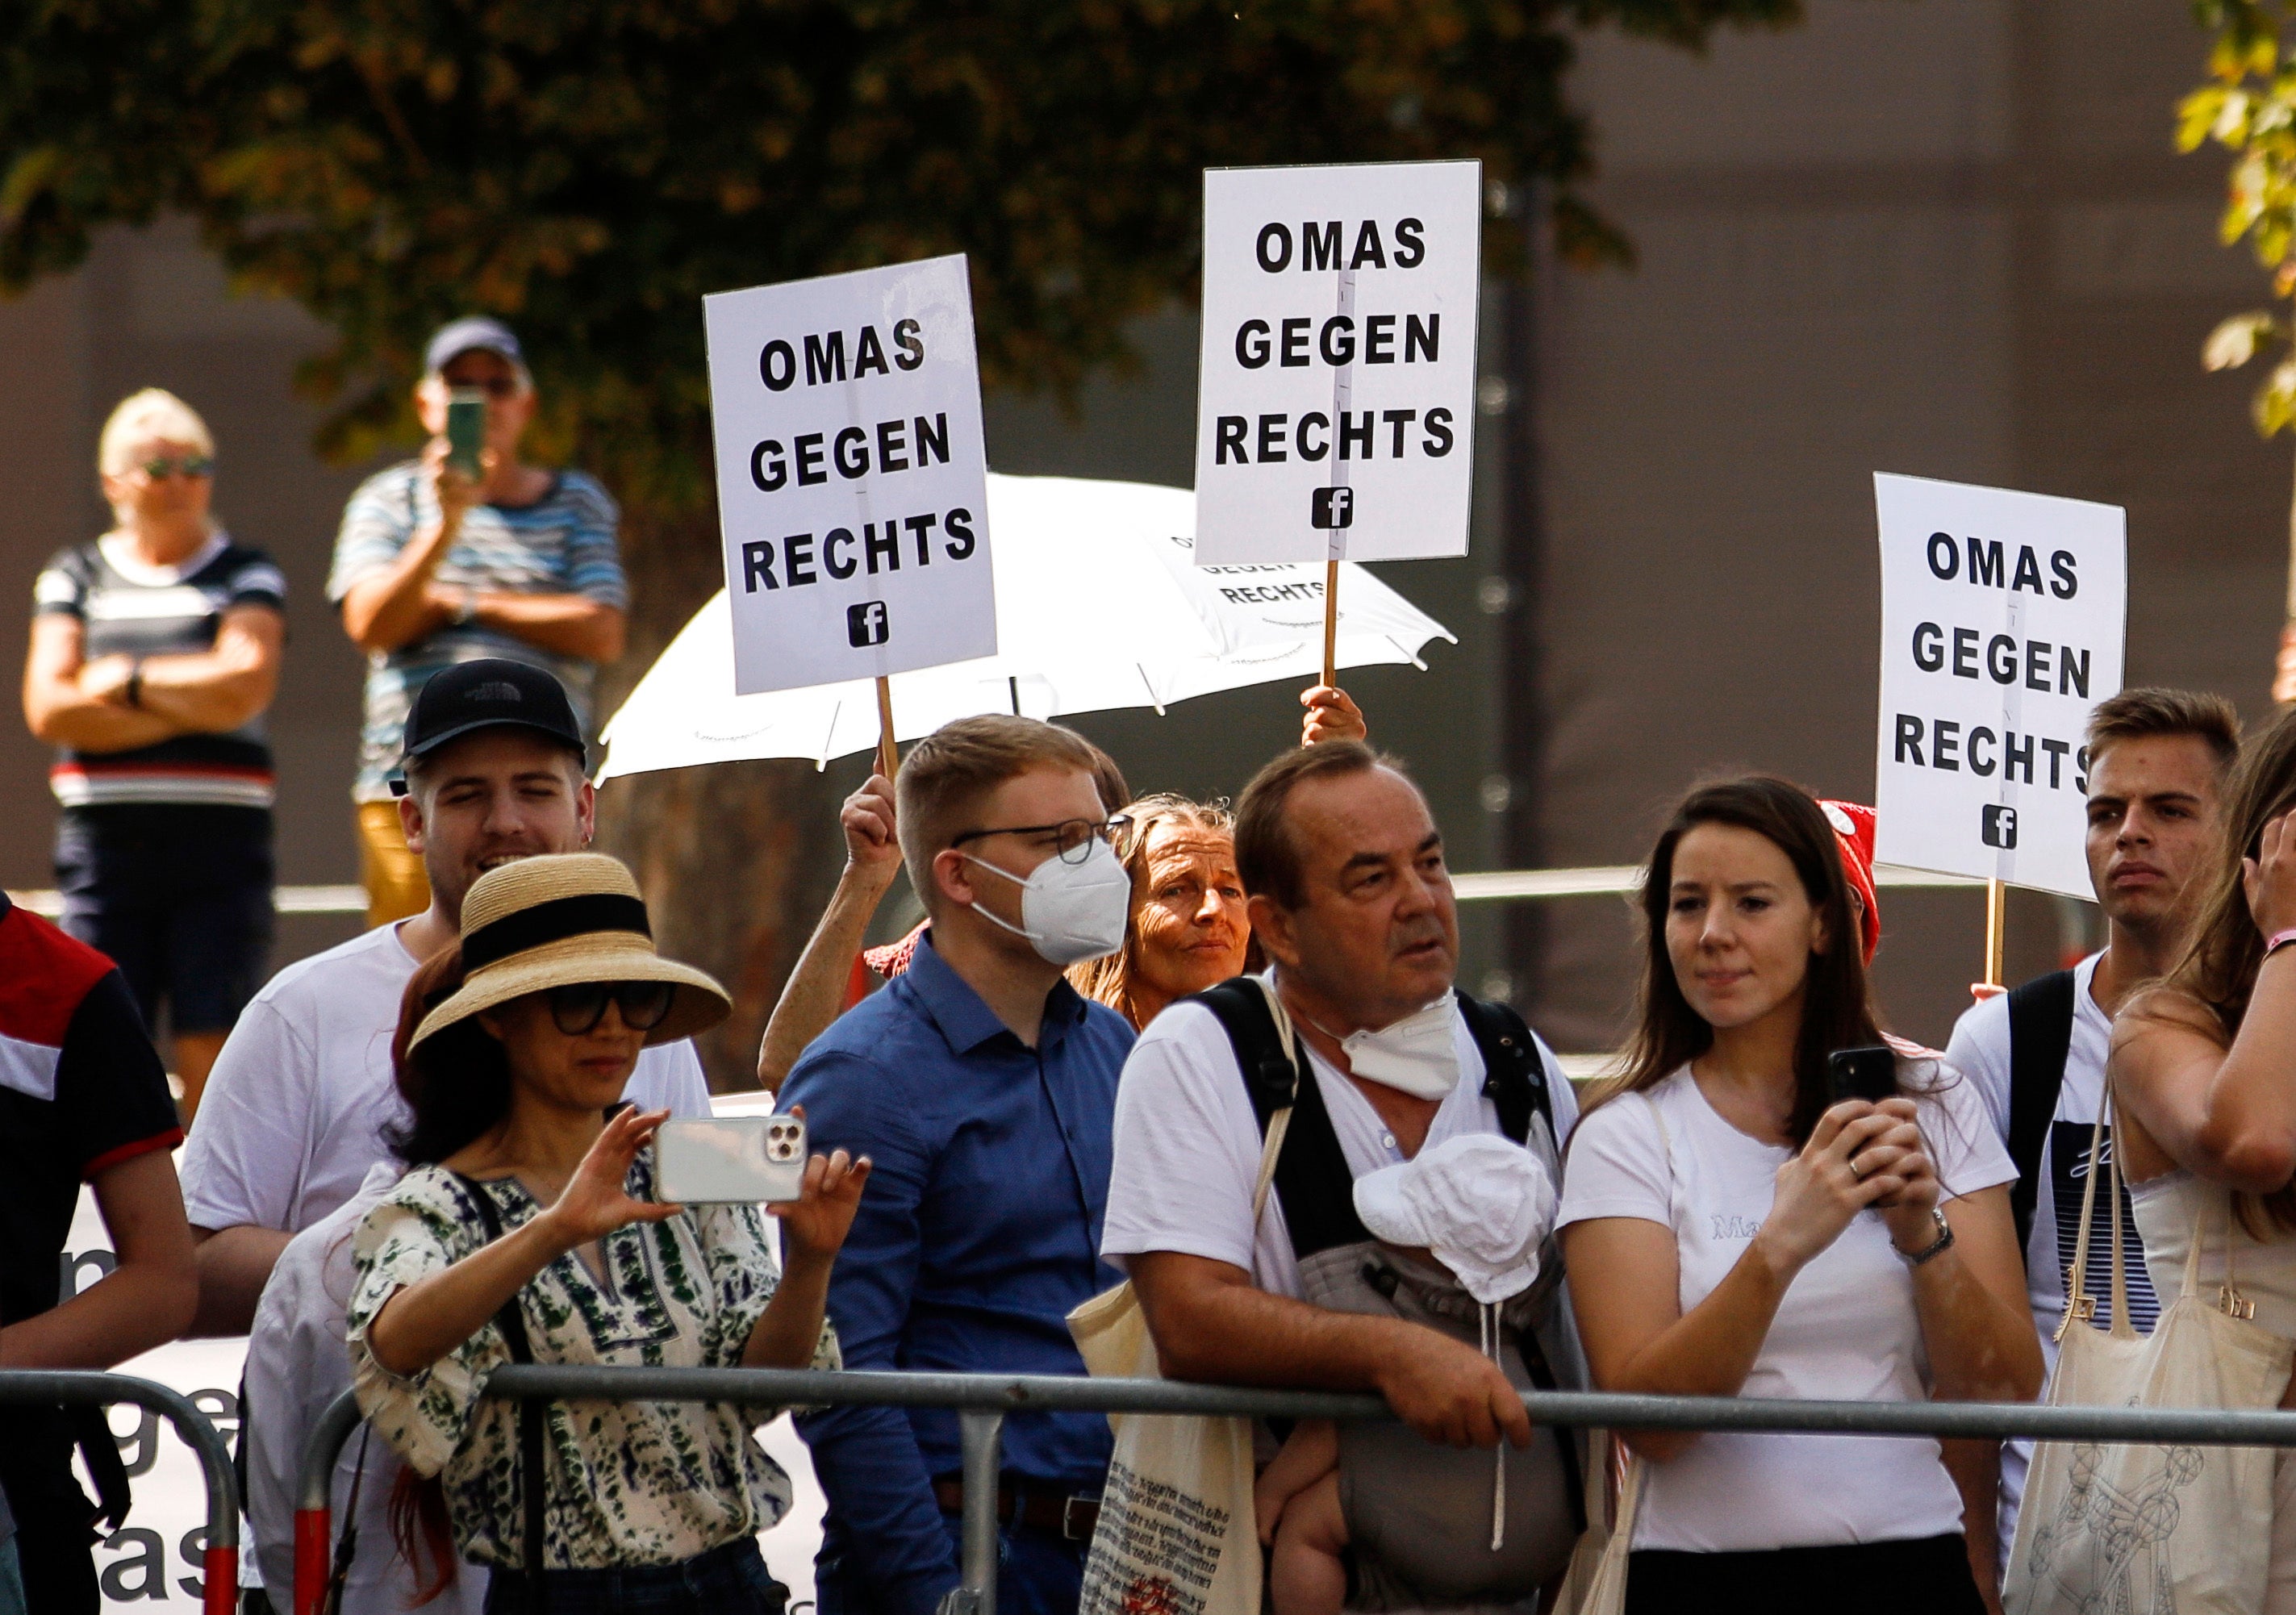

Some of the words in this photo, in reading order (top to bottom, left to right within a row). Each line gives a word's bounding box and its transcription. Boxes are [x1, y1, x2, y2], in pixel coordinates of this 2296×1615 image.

[1256, 217, 1426, 273] OMAS
[759, 319, 925, 392] OMAS
[1235, 313, 1440, 369] GEGEN
[750, 412, 950, 492] GEGEN
[1215, 407, 1454, 465] RECHTS
[741, 507, 975, 594] RECHTS
[1927, 532, 2077, 600] OMAS
[1912, 621, 2090, 699] GEGEN
